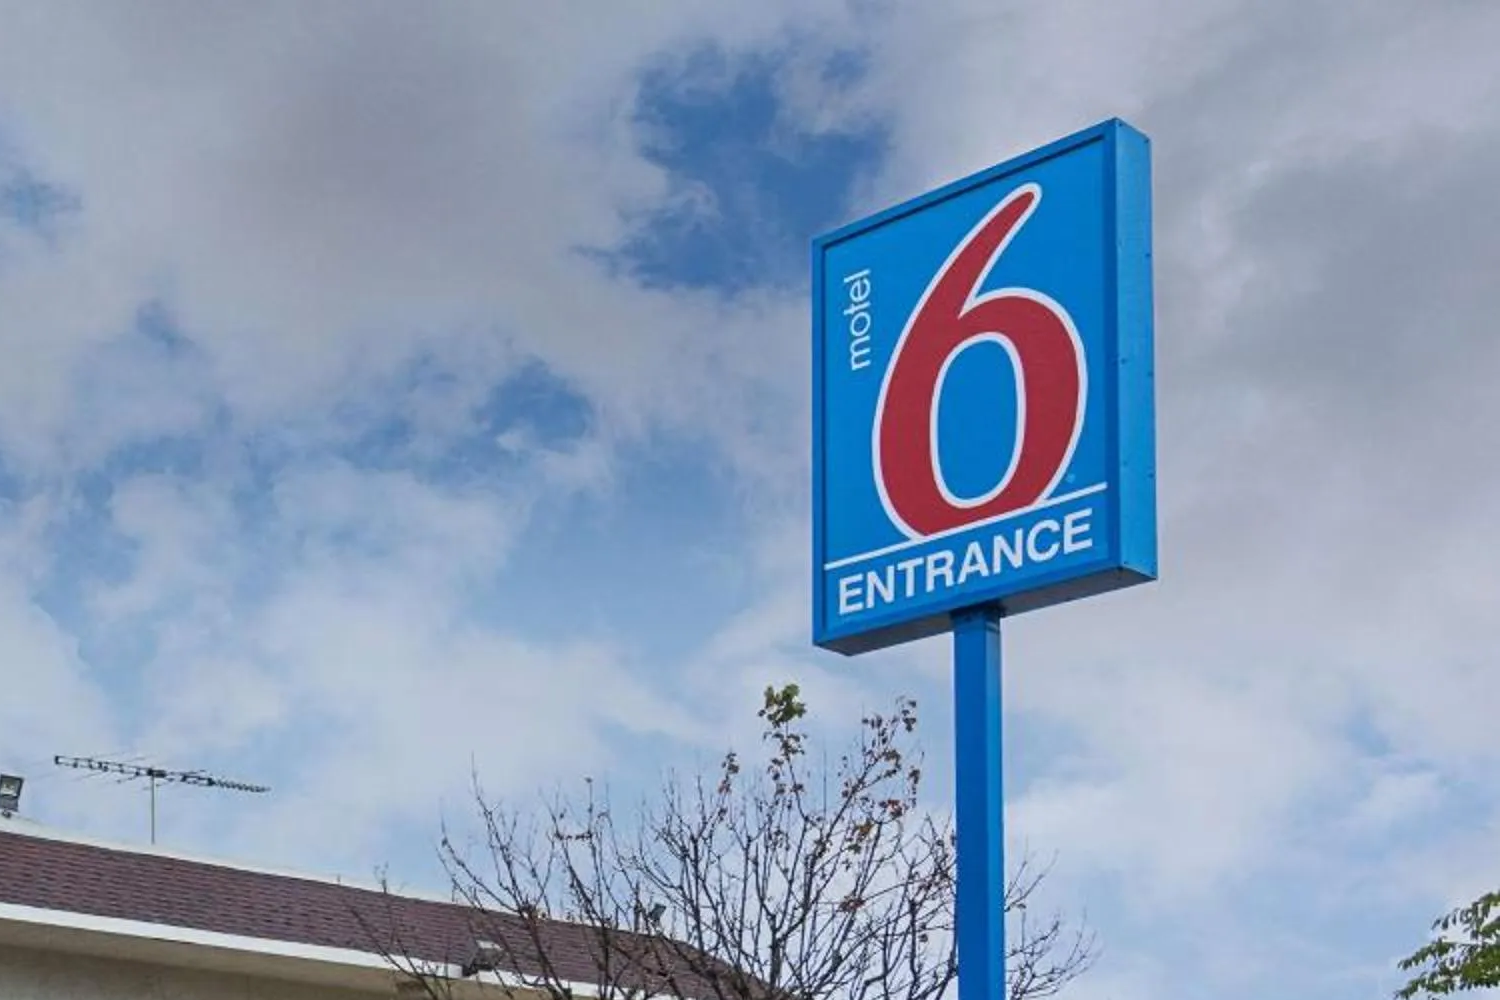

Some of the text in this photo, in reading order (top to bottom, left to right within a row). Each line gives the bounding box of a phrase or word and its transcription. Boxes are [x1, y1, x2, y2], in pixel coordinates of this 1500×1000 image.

[843, 268, 871, 371] motel
[871, 181, 1088, 543] 6
[837, 507, 1093, 616] ENTRANCE
